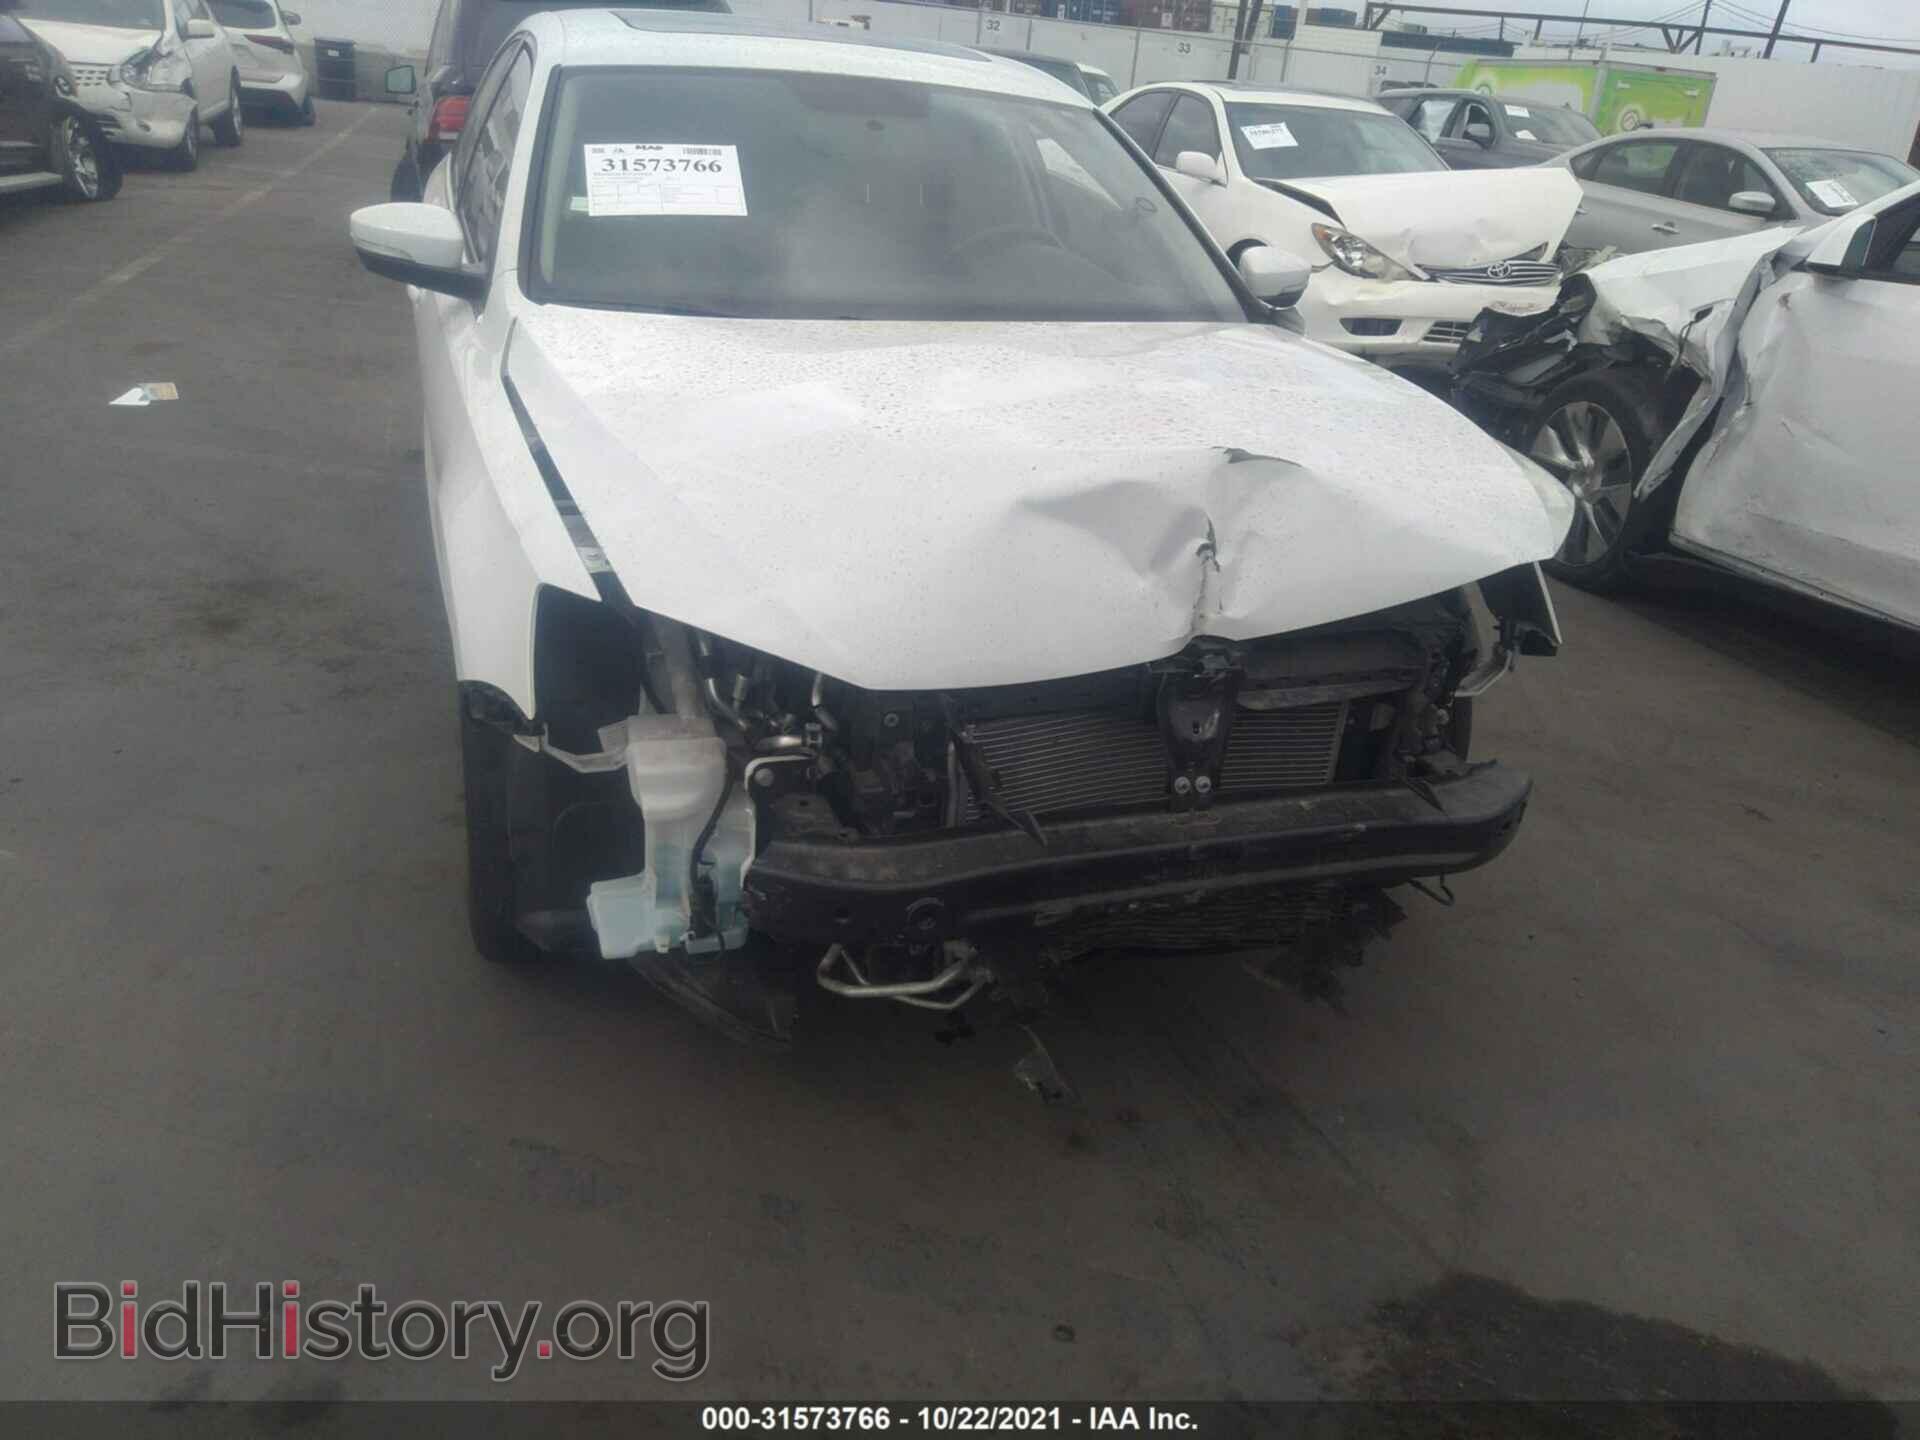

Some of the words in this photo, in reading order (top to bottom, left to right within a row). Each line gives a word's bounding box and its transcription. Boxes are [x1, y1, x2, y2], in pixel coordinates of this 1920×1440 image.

[985, 19, 1001, 32] 32
[1177, 42, 1191, 54] 33
[601, 158, 722, 172] 31573766
